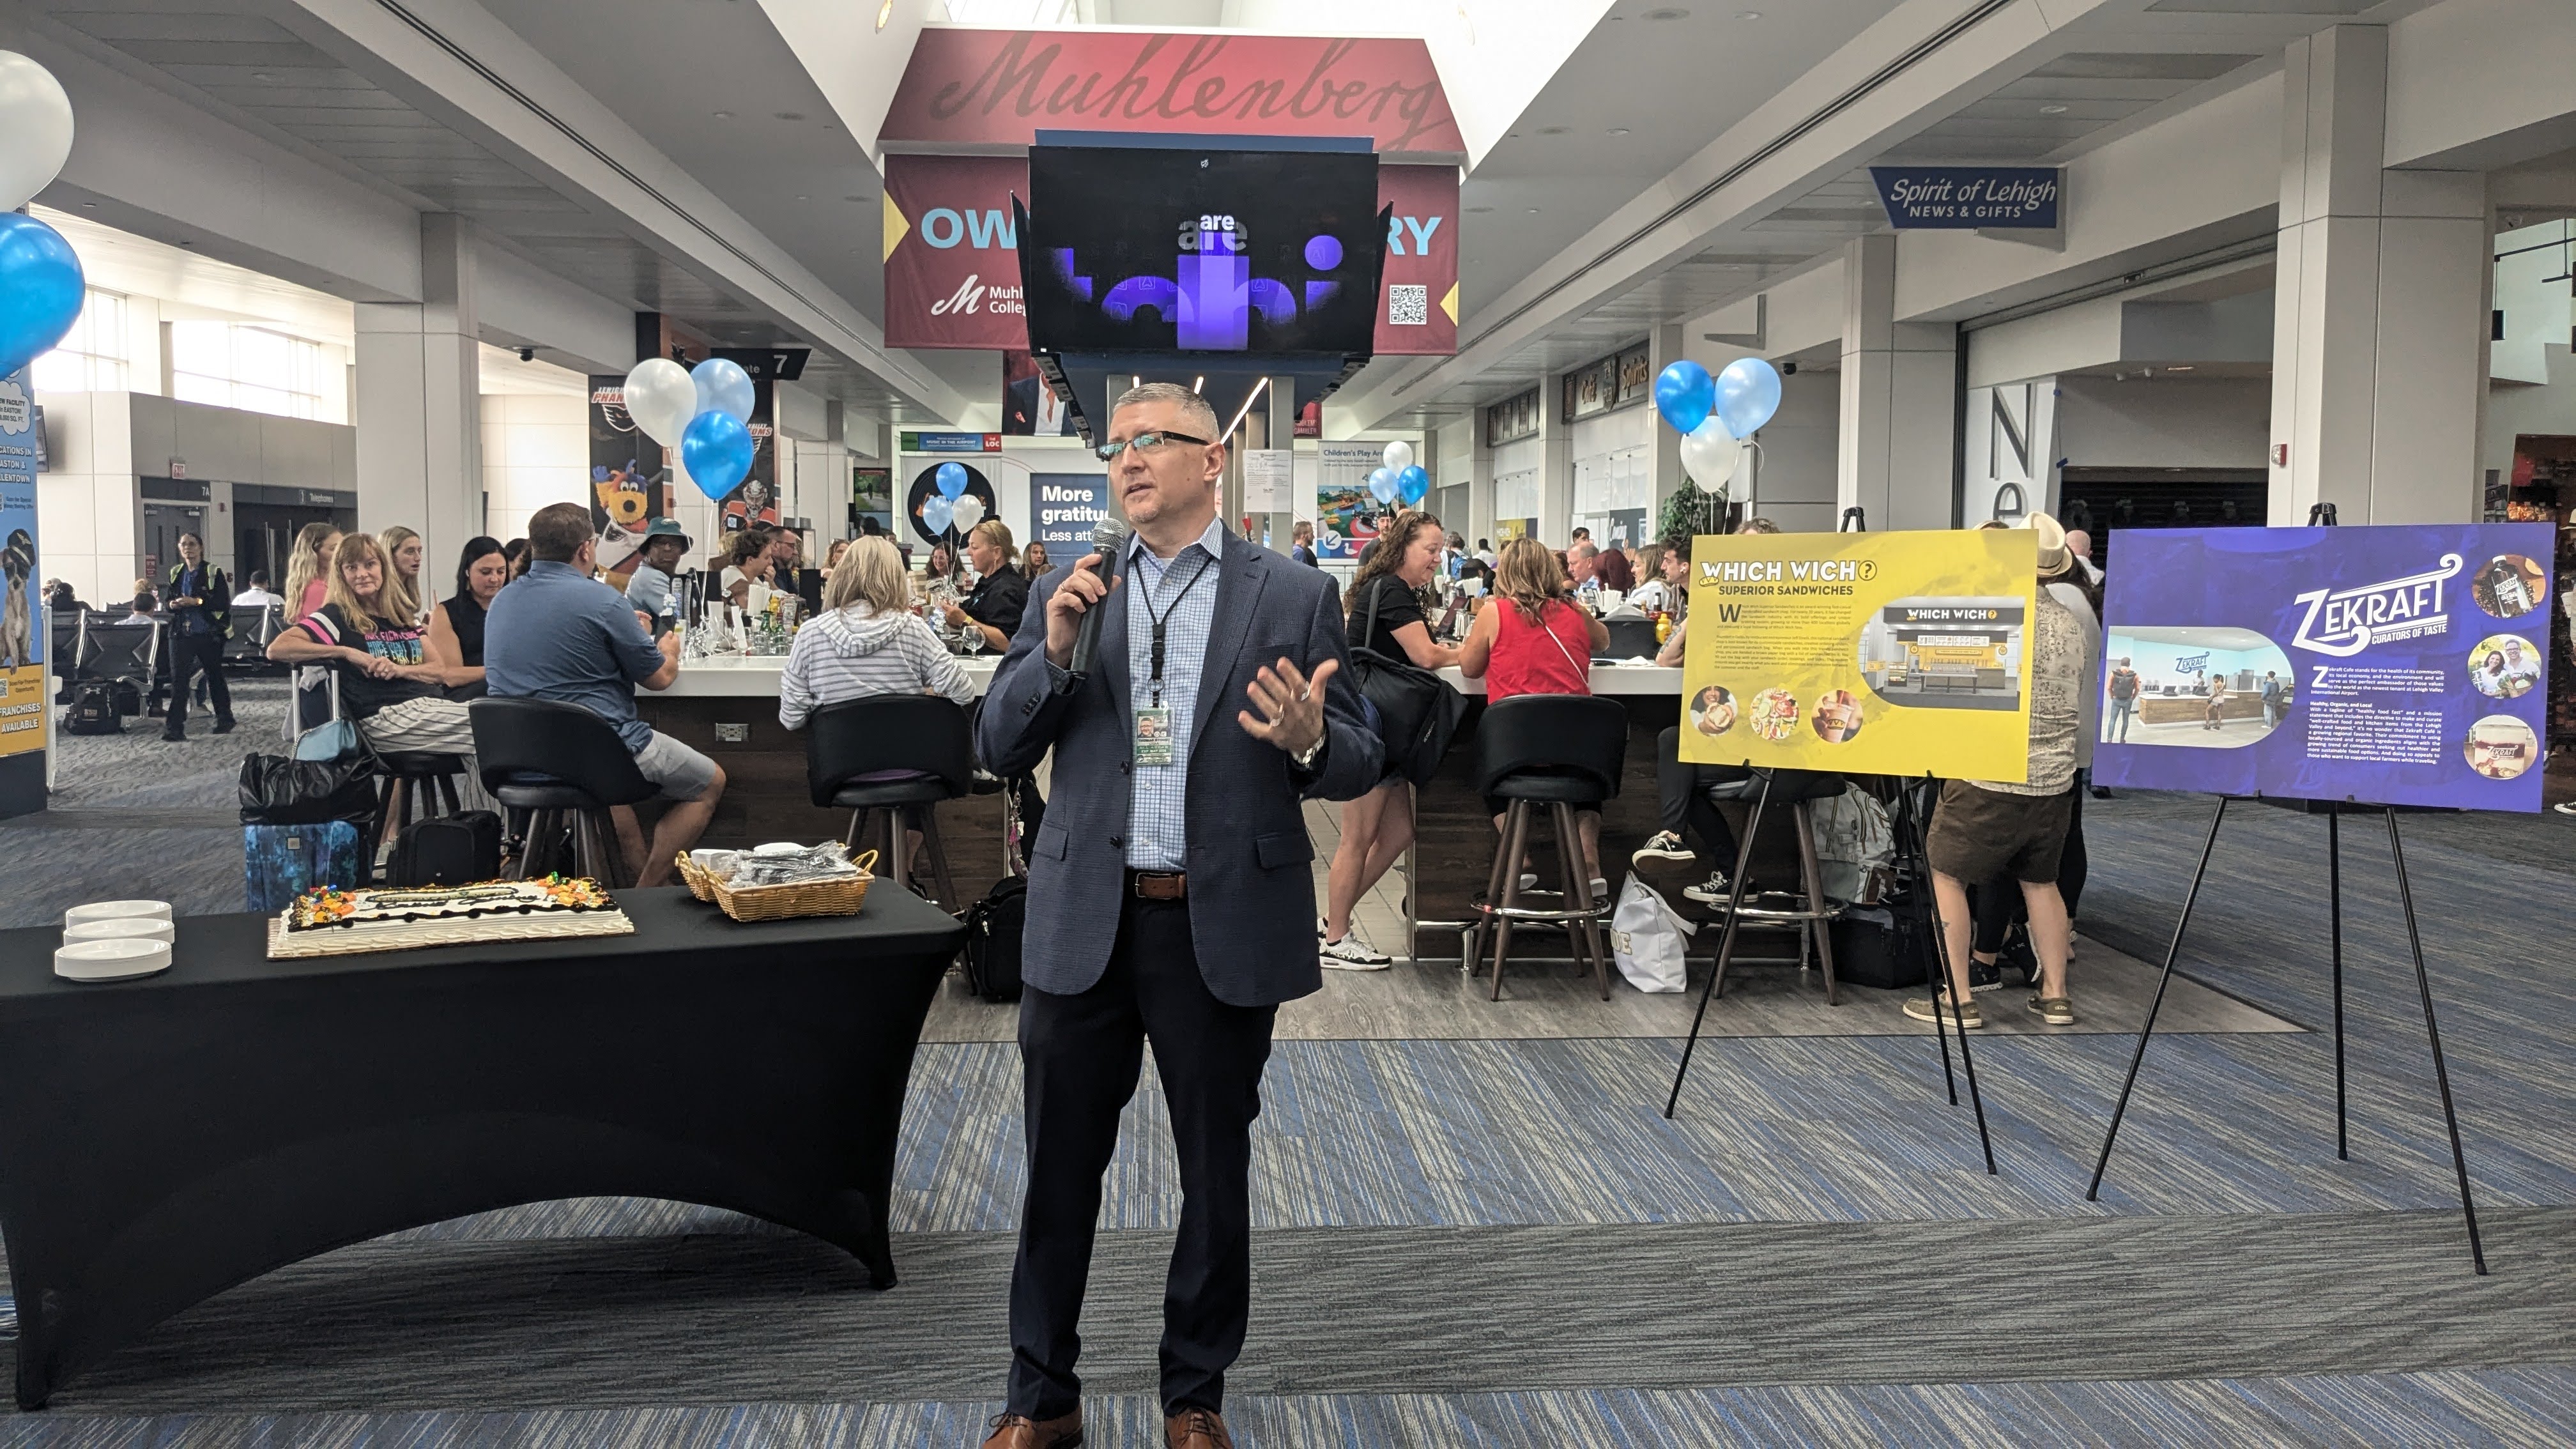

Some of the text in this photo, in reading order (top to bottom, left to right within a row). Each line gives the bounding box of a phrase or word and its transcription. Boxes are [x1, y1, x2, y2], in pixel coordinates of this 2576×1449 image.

[928, 31, 1453, 151] Muhlenberg
[1890, 178, 2057, 210] Spirit of Lehigh
[1909, 206, 2021, 218] NEWS & GIFTS
[921, 208, 1030, 249] OW
[1200, 215, 1235, 231] are
[990, 300, 1026, 317] Colle
[746, 355, 788, 374] ate 7
[592, 392, 625, 403] PHAN
[0, 460, 20, 468] ASTON
[1, 474, 30, 483] LENTOWN
[202, 486, 210, 496] 7A
[1043, 486, 1093, 502] More
[1042, 506, 1108, 525] gratitu
[1043, 529, 1071, 541] Less
[1700, 560, 1782, 582] WHICH
[1719, 585, 1853, 595] SUPERIOR SANDWICHES
[2292, 553, 2463, 657] ZEKRAFT
[1908, 609, 1949, 619] WHICH
[2372, 623, 2447, 645] CURATORS OF TASTE
[2175, 651, 2210, 673] ZEKRAFT
[0, 703, 42, 716] FRANCHISES
[1, 719, 39, 733] AVAILABLE
[2487, 745, 2518, 760] ZEKRAFT
